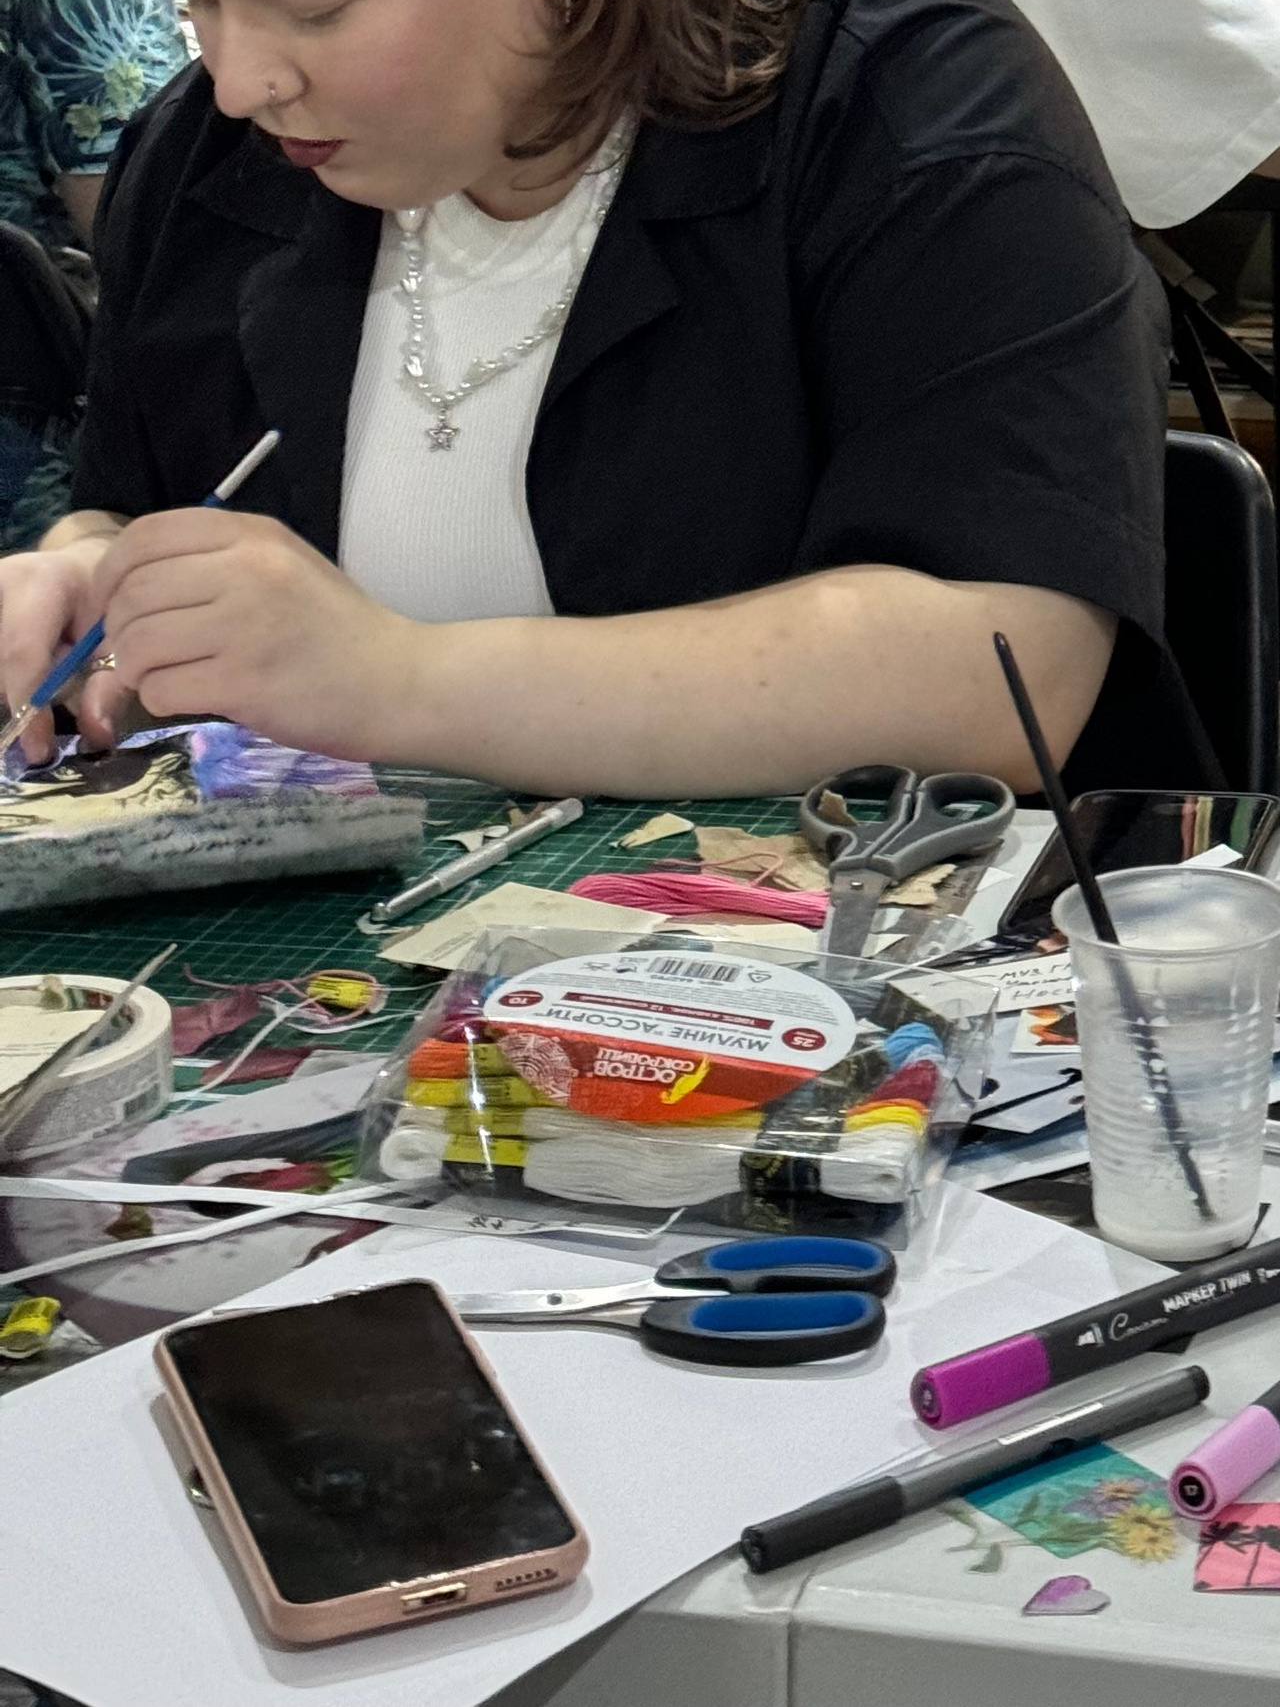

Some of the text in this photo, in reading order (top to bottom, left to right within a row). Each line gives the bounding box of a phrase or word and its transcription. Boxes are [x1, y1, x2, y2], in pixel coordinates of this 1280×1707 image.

[668, 1026, 771, 1052] МУЛИНЕ
[592, 1060, 677, 1082] ОСТРОВ
[595, 1048, 695, 1072] СОКРОВИЩ
[1218, 1269, 1252, 1293] TWIN
